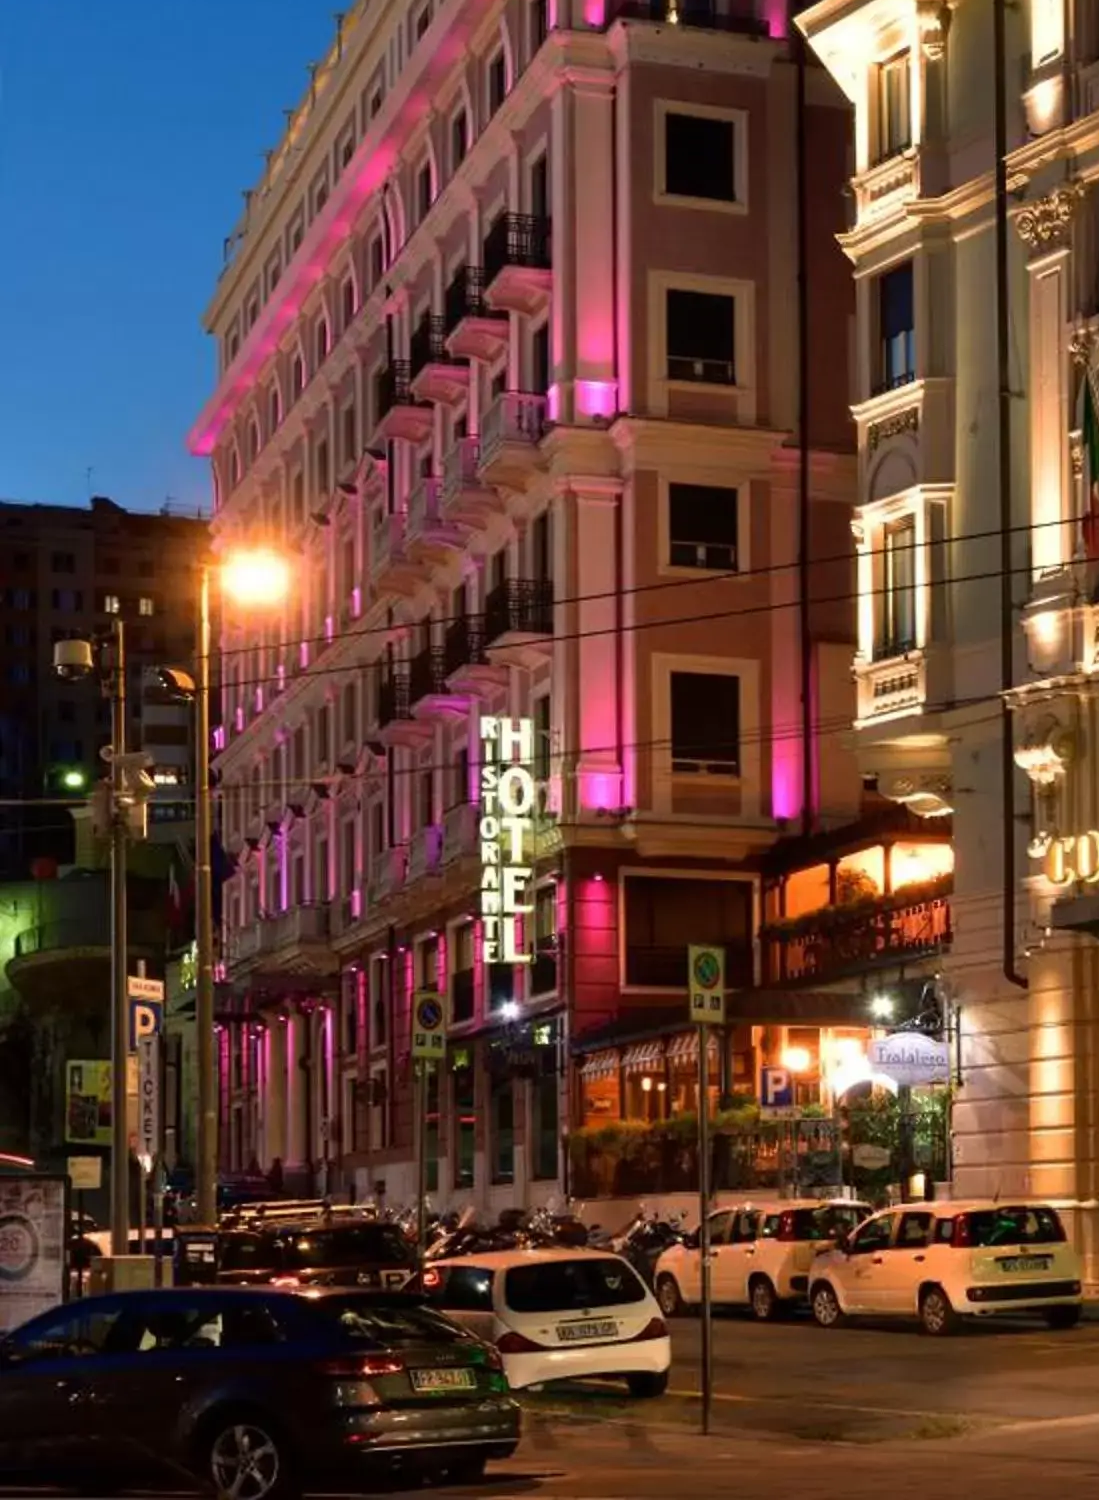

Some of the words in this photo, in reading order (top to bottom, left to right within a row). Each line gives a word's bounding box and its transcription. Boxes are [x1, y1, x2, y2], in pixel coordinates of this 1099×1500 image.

[479, 716, 499, 963] RISTORANTE
[500, 717, 535, 963] HOTEL
[134, 1004, 155, 1047] P
[143, 1041, 153, 1150] TICKET
[767, 1069, 787, 1104] P
